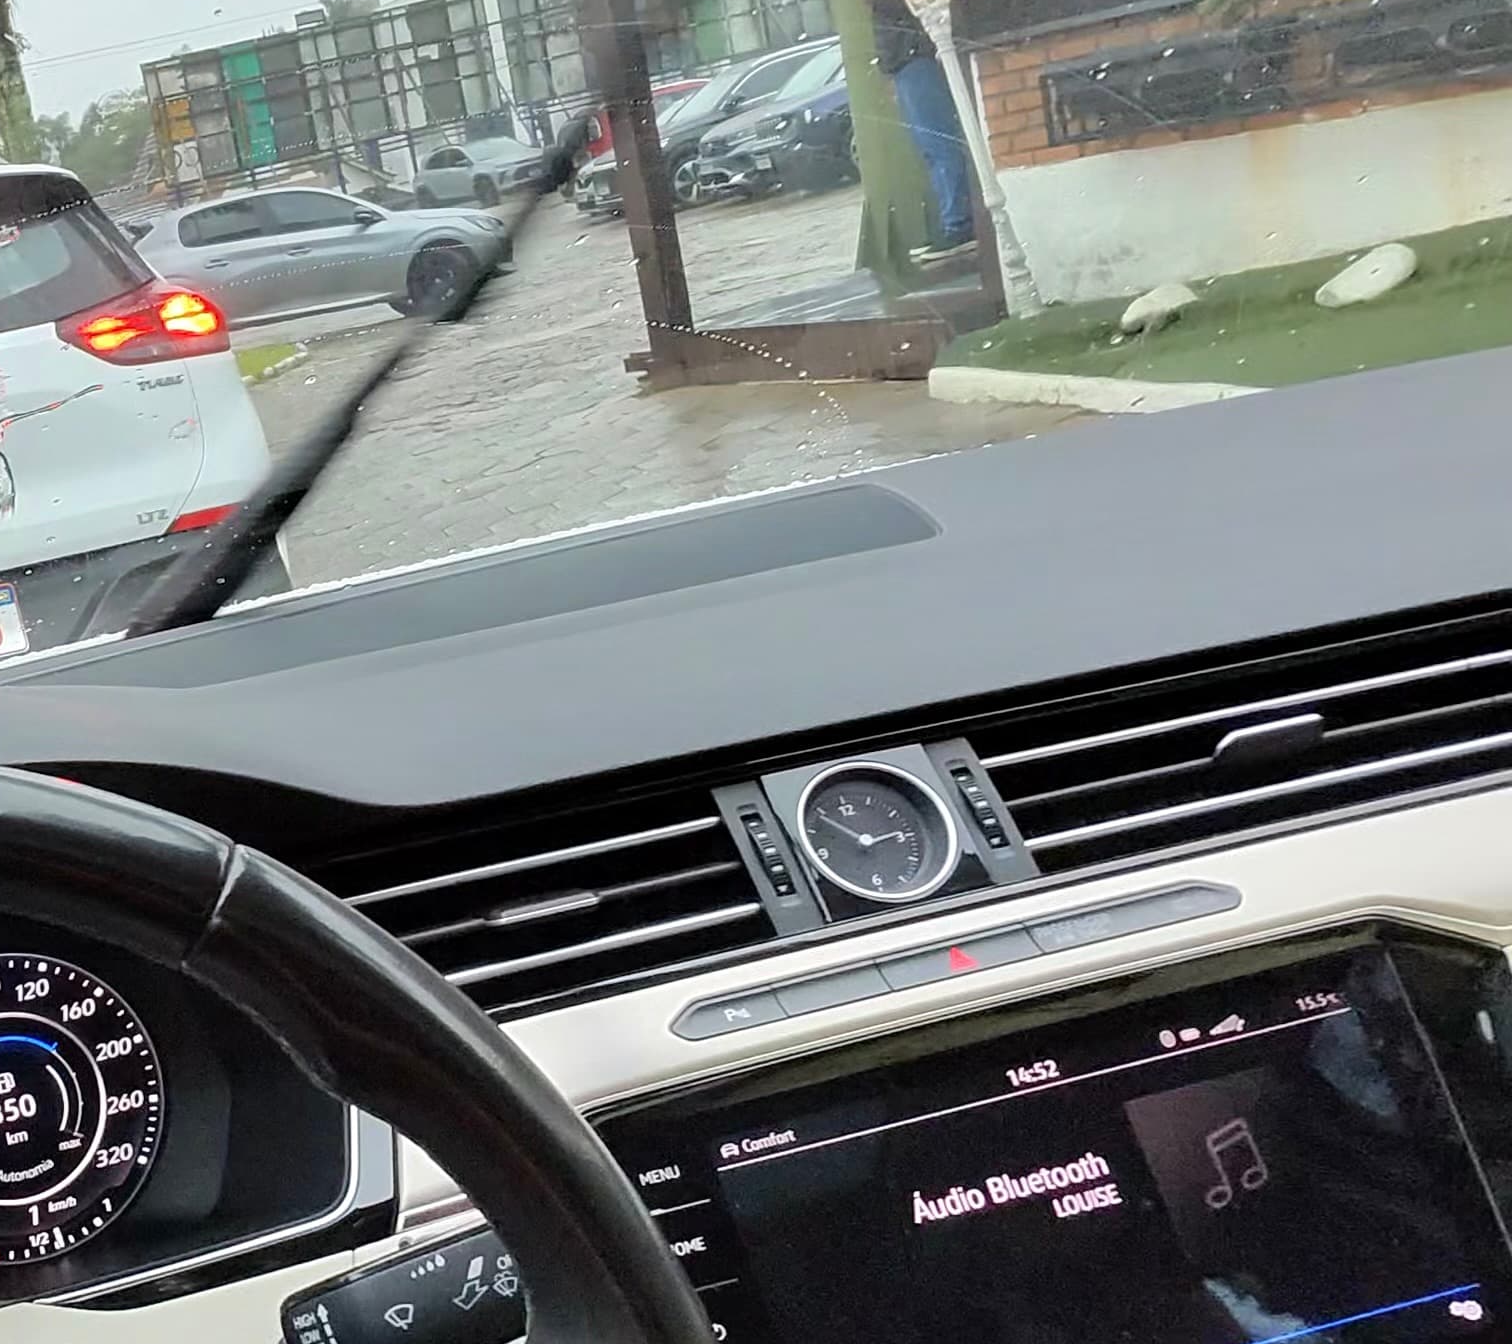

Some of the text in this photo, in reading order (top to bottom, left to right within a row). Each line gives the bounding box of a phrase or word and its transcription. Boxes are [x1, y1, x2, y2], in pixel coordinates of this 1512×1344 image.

[838, 804, 856, 817] 12
[817, 847, 830, 860] 9
[871, 873, 883, 886] 6
[14, 978, 50, 1002] 120
[60, 998, 96, 1022] 160
[95, 1036, 132, 1061] 200
[1006, 1059, 1060, 1087] 14:52
[106, 1090, 144, 1115] 260
[5, 1131, 29, 1146] km
[58, 1138, 82, 1152] max
[741, 1129, 797, 1153] Comfort
[95, 1143, 134, 1169] 320
[638, 1164, 681, 1187] MENU
[912, 1151, 1110, 1224] Áudio Bluetooth
[28, 1196, 77, 1227] 1 km/h
[102, 1197, 113, 1213] 1
[1052, 1183, 1123, 1218] LOUISE
[29, 1232, 50, 1248] 1/2
[670, 1236, 707, 1256] OME
[292, 1311, 317, 1329] HIGH
